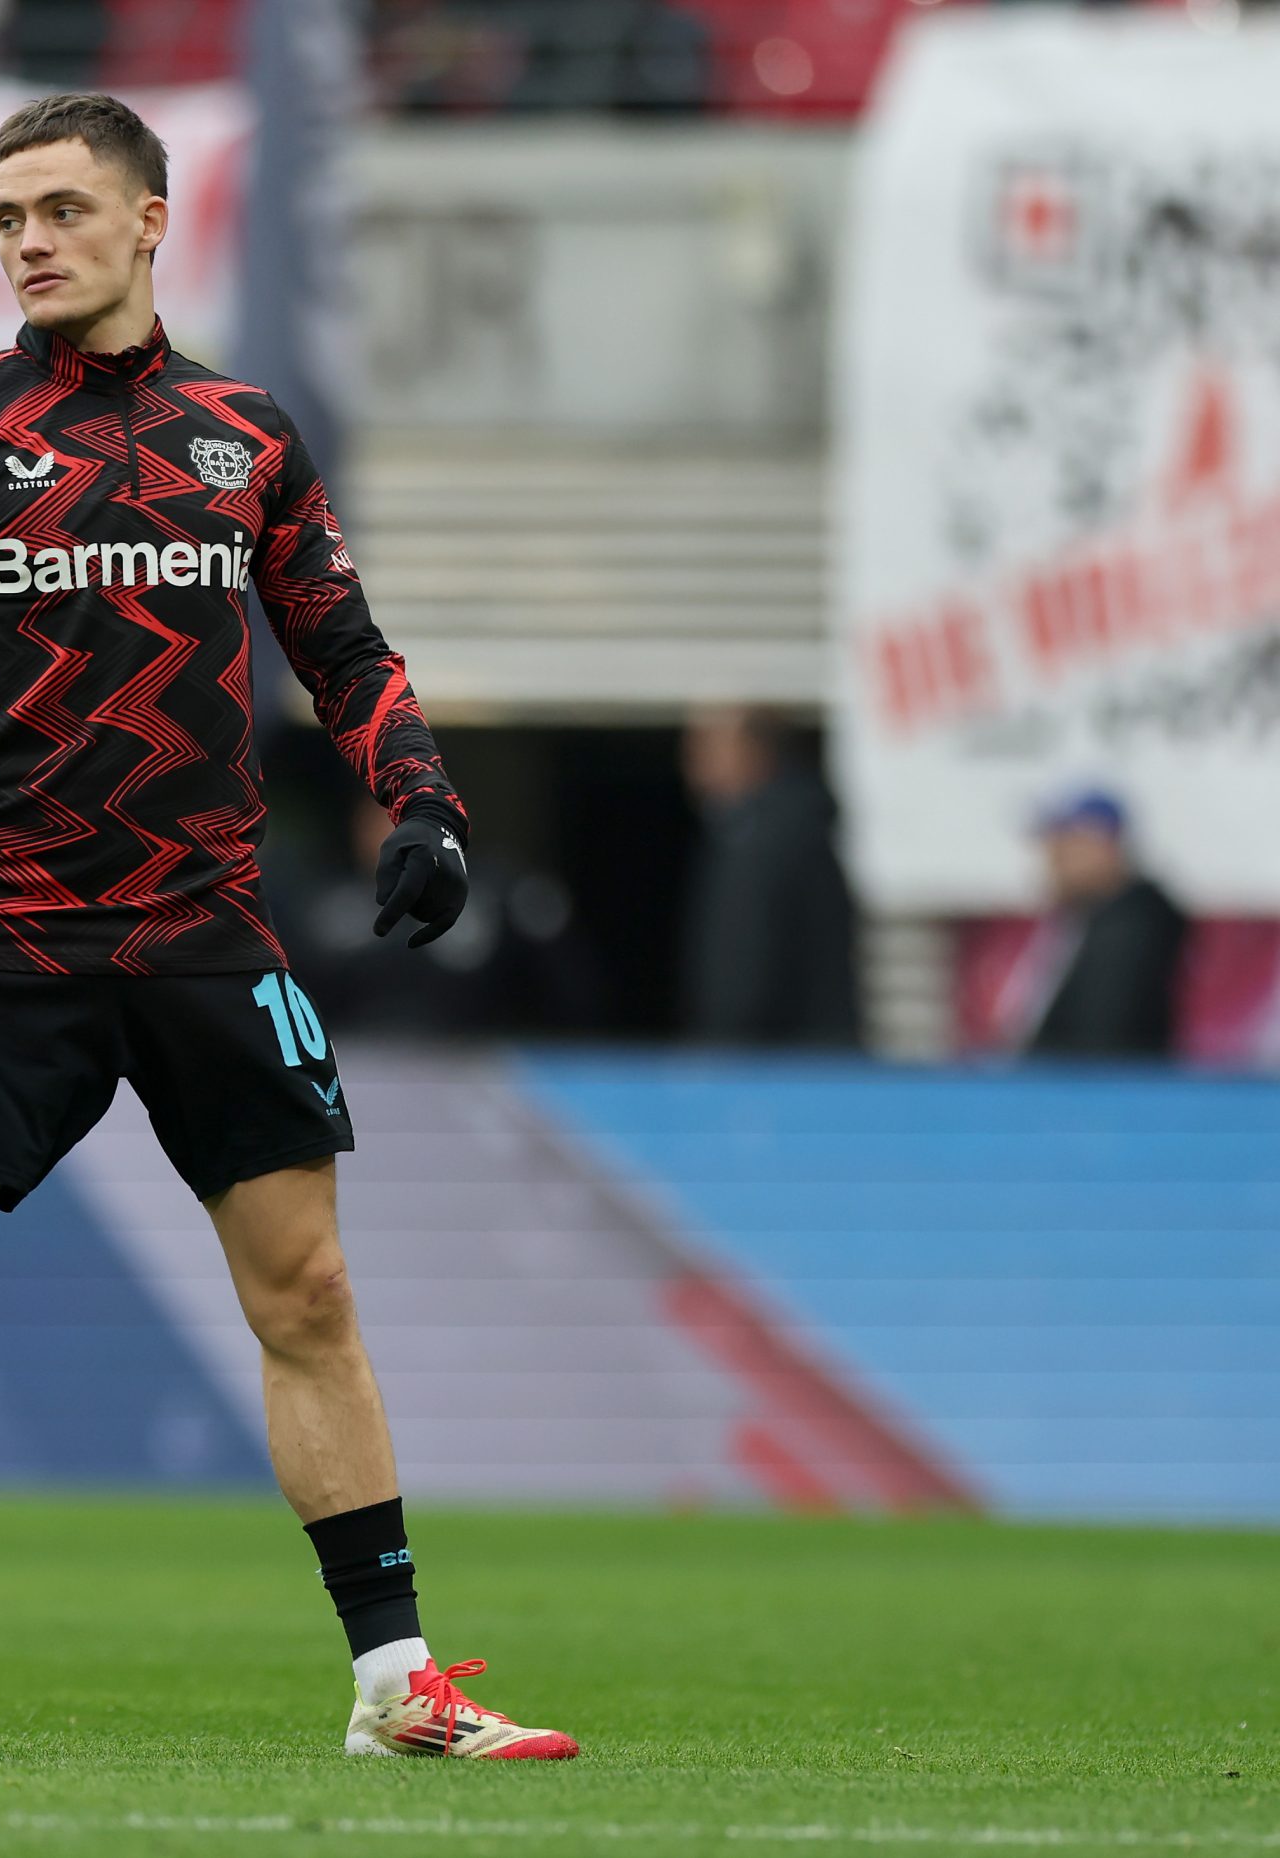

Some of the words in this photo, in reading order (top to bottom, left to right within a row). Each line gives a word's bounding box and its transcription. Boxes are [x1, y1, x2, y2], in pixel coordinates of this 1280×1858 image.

[210, 460, 235, 468] BAYER
[8, 480, 56, 490] CASTORE
[204, 474, 245, 486] Leverkusen
[252, 971, 327, 1067] 10
